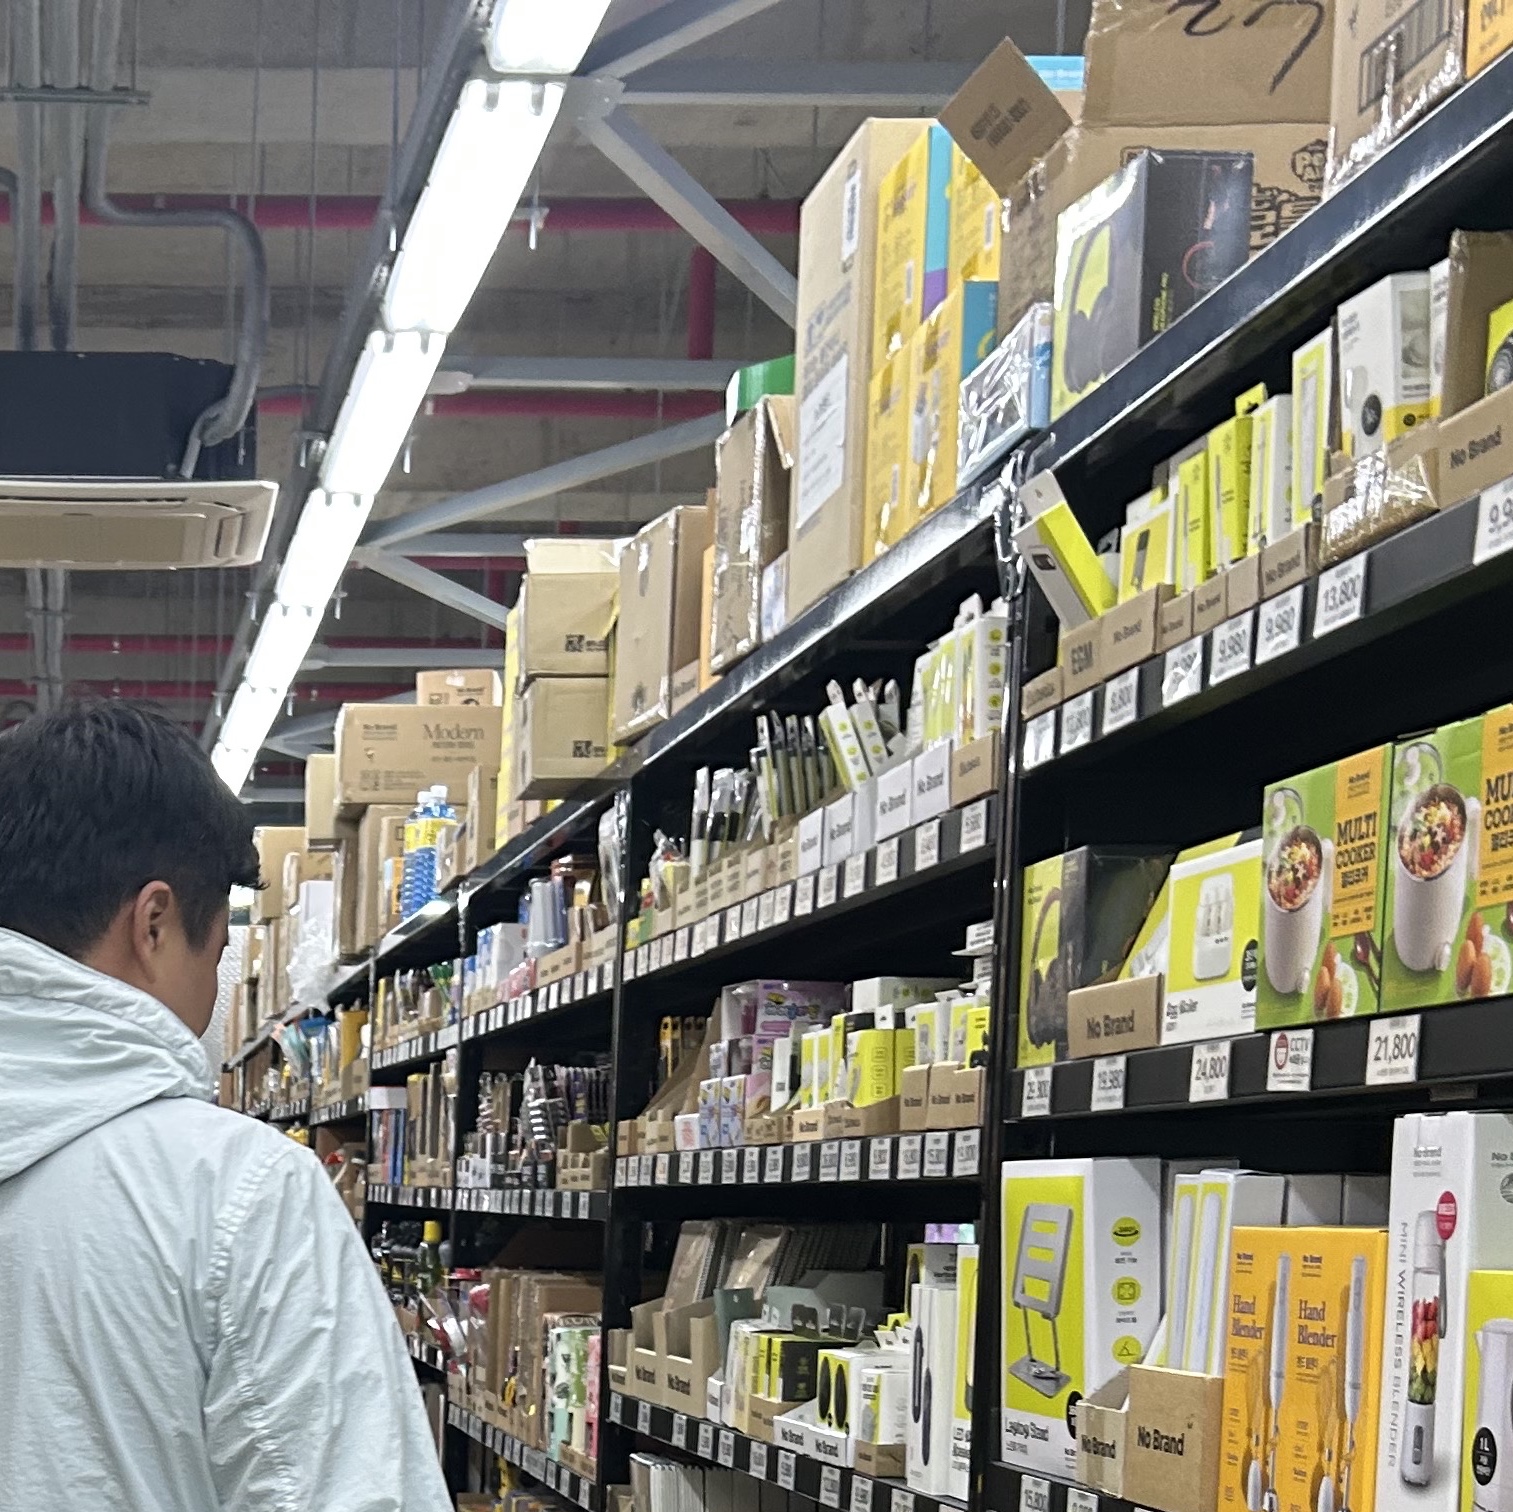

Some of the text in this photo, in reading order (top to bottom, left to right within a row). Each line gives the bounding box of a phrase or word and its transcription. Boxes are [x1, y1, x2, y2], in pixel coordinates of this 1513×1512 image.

[422, 723, 485, 741] Modern
[1336, 811, 1378, 847] MULTI
[1335, 841, 1376, 870] COOKER
[1087, 1009, 1136, 1040] No Brand
[1373, 1031, 1418, 1063] 21,800
[1195, 1055, 1228, 1083] 24,800
[1298, 1298, 1326, 1322] Hand
[1393, 1269, 1406, 1370] WIRELESS
[1297, 1323, 1338, 1349] Blender
[1387, 1375, 1402, 1468] BLENDER
[1138, 1425, 1185, 1456] No Brand
